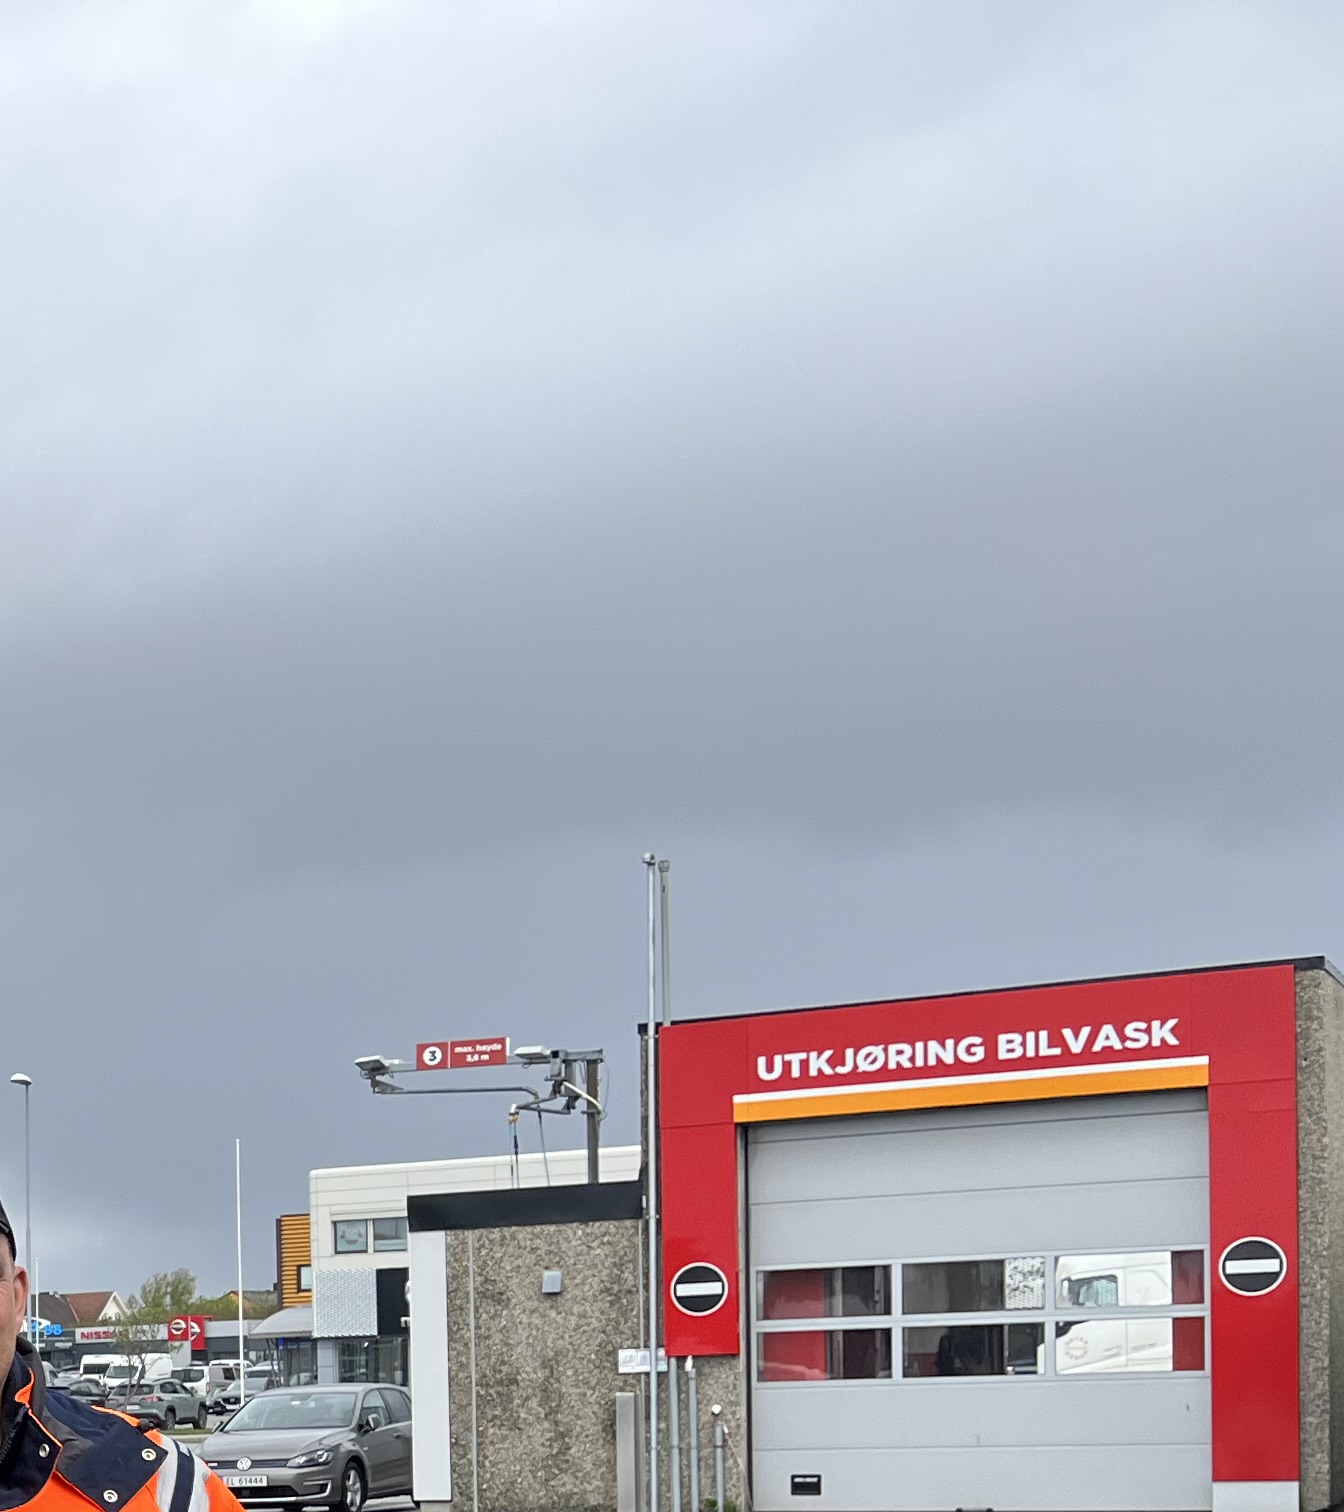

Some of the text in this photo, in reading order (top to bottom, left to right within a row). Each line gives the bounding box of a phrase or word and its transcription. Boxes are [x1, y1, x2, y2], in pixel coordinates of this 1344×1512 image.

[428, 1050, 437, 1062] 3
[756, 1018, 1180, 1081] UTKJØRING BILVASK
